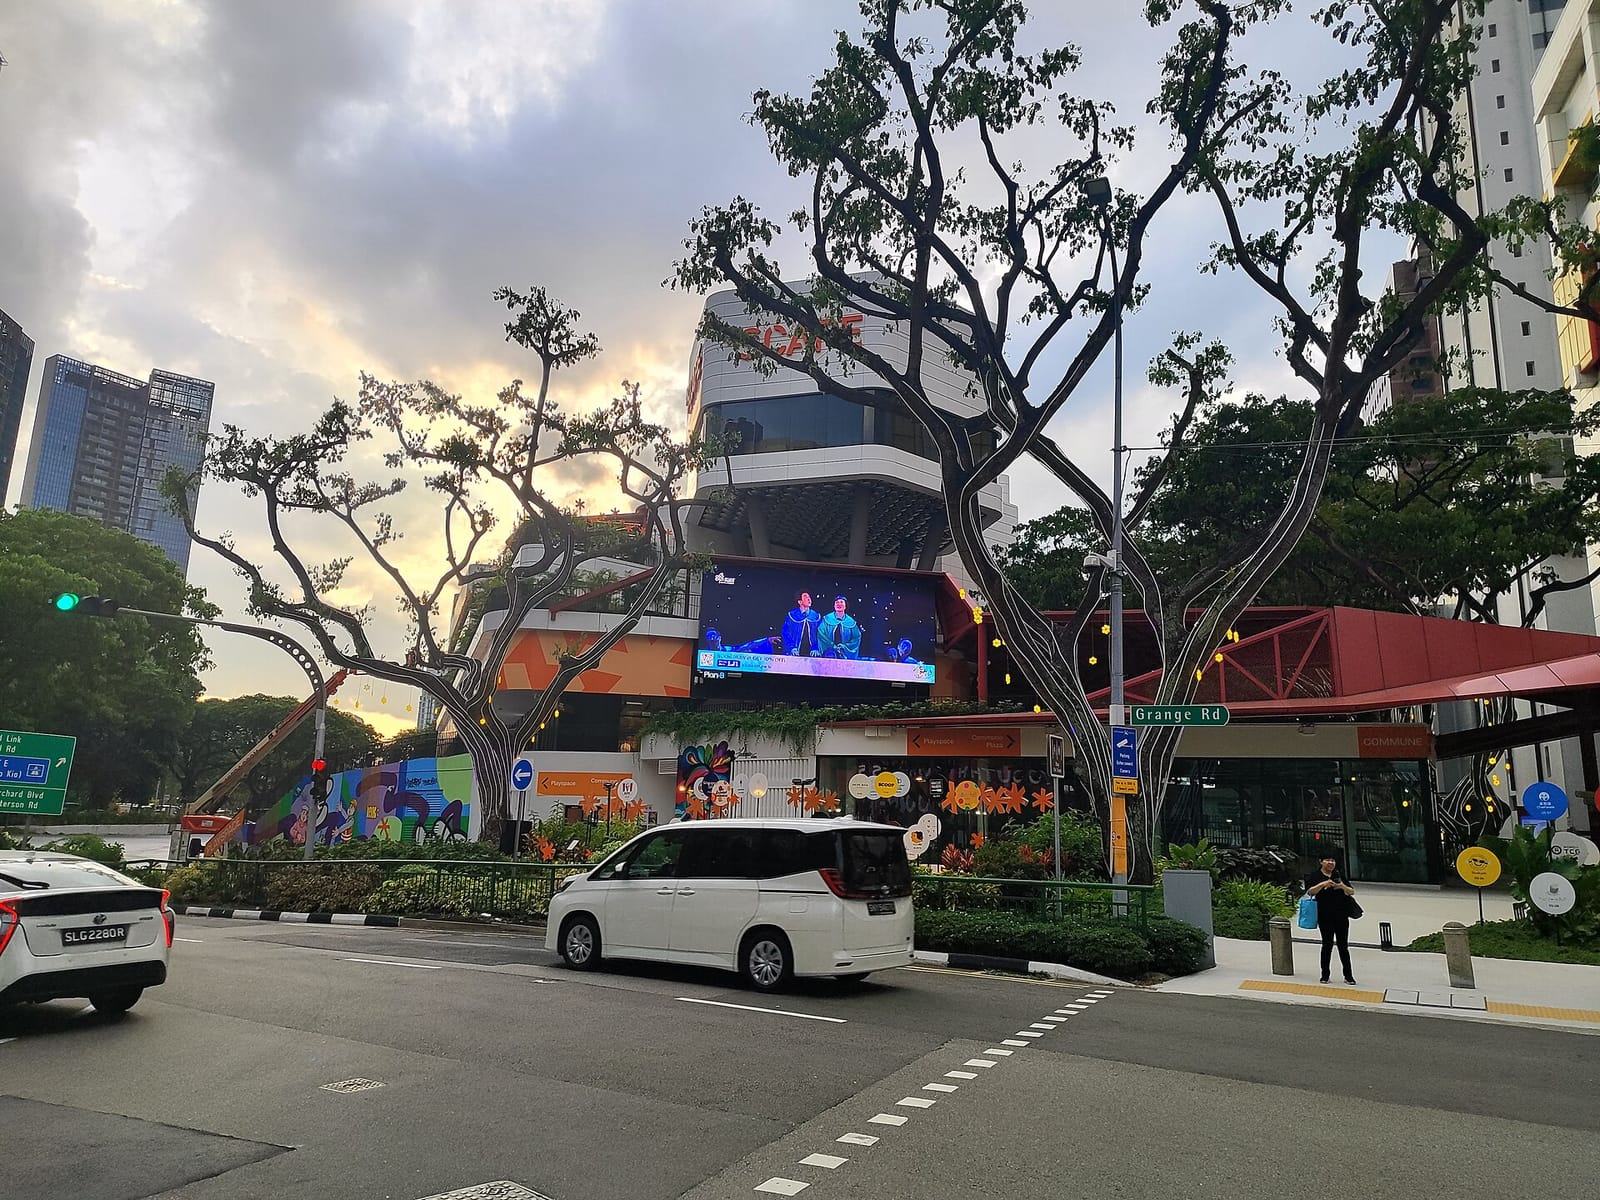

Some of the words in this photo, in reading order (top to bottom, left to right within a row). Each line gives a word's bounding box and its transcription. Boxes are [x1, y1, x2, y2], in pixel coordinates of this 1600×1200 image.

[1135, 707, 1192, 723] Grange
[1201, 707, 1220, 720] Rd
[6, 735, 22, 743] Link
[1363, 737, 1423, 746] COMMUNE
[6, 745, 17, 753] Rd
[3, 759, 9, 767] E
[0, 789, 24, 798] chard
[27, 791, 44, 799] Blvd
[28, 801, 39, 809] Rd
[64, 927, 125, 942] SLG2280R
